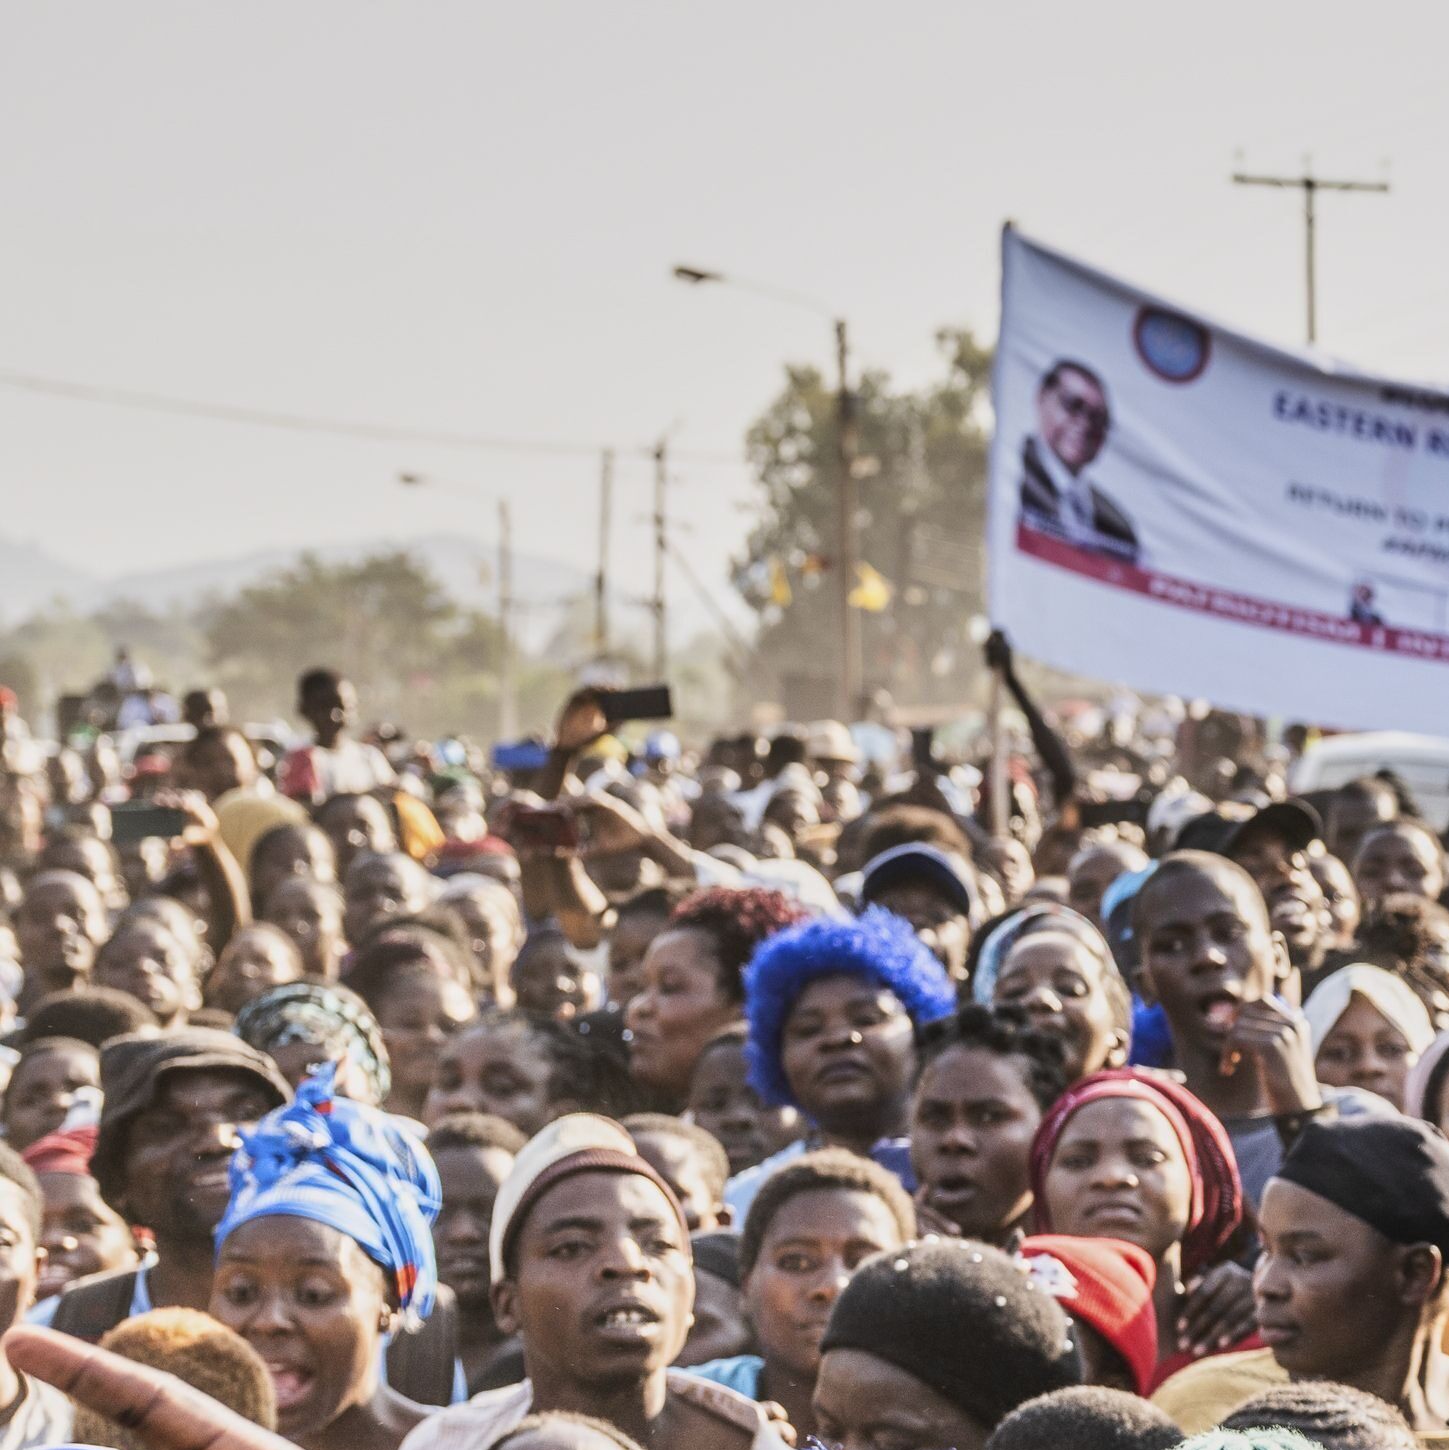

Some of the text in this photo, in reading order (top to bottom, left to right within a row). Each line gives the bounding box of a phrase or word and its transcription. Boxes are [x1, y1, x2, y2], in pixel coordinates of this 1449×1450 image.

[1273, 391, 1416, 449] EASTERN
[1286, 480, 1388, 522] RETURN
[1394, 503, 1428, 531] TO
